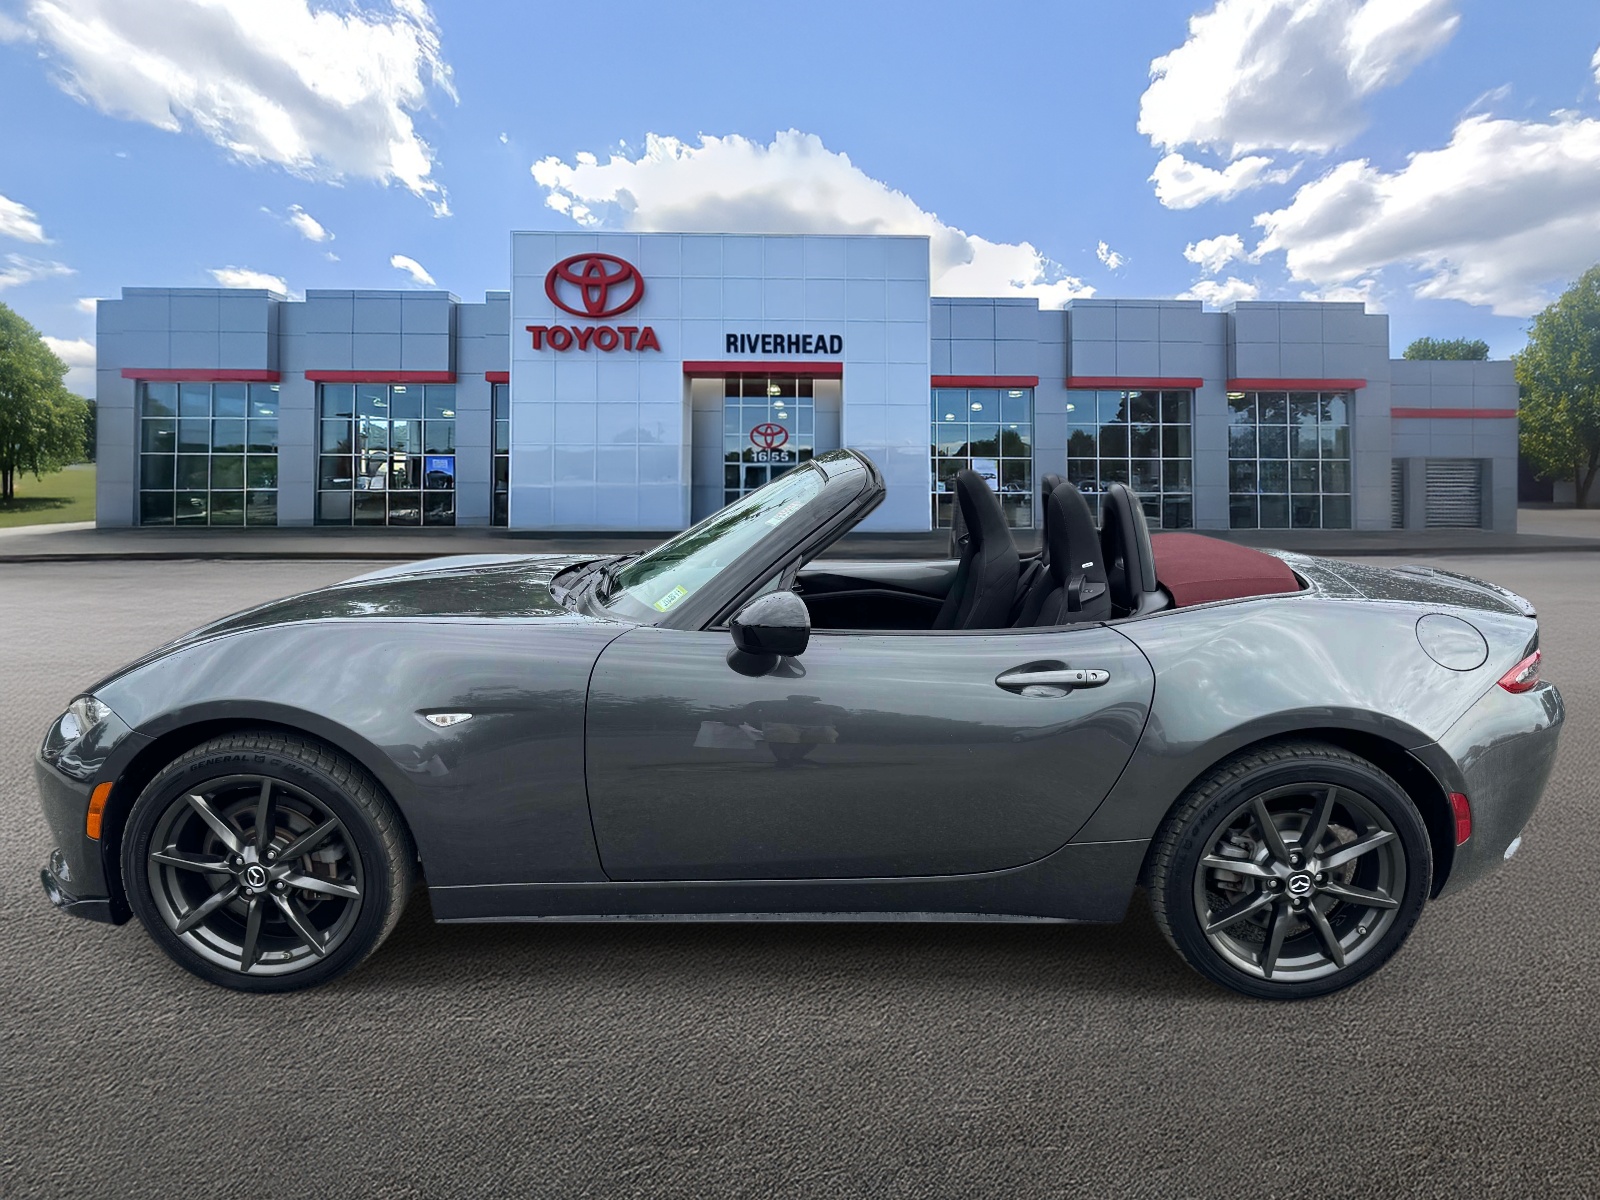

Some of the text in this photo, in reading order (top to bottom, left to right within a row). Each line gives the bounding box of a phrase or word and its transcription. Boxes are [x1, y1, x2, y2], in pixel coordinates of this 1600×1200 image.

[526, 325, 661, 352] TOYOTA
[725, 333, 843, 354] RIVERHEAD
[751, 451, 789, 462] 1655
[190, 755, 249, 771] GENERAL
